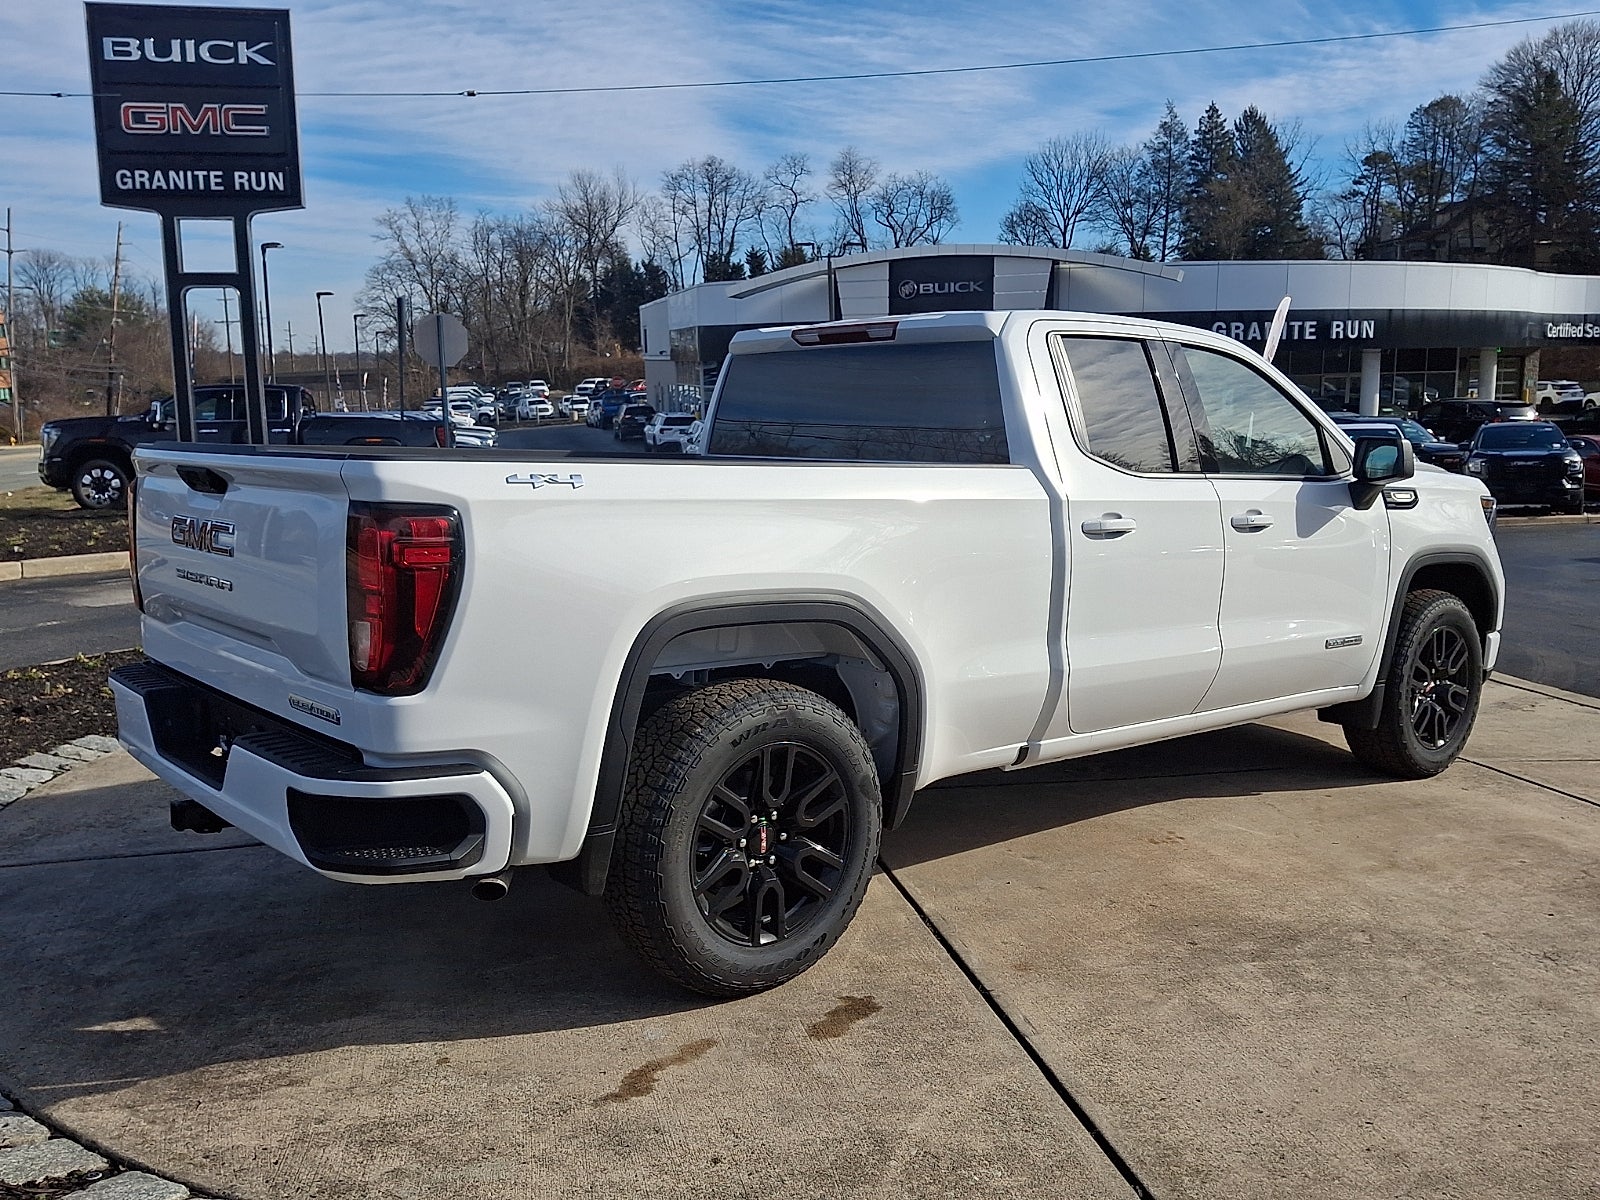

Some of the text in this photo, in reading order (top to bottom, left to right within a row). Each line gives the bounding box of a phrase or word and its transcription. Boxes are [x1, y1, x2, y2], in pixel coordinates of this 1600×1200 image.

[102, 36, 276, 66] BUICK
[121, 101, 270, 136] GMC
[115, 169, 285, 192] GRANITE RUN
[919, 281, 985, 294] BUICK
[1331, 320, 1375, 339] RUN
[1547, 322, 1583, 338] Certified
[172, 514, 236, 558] GMC
